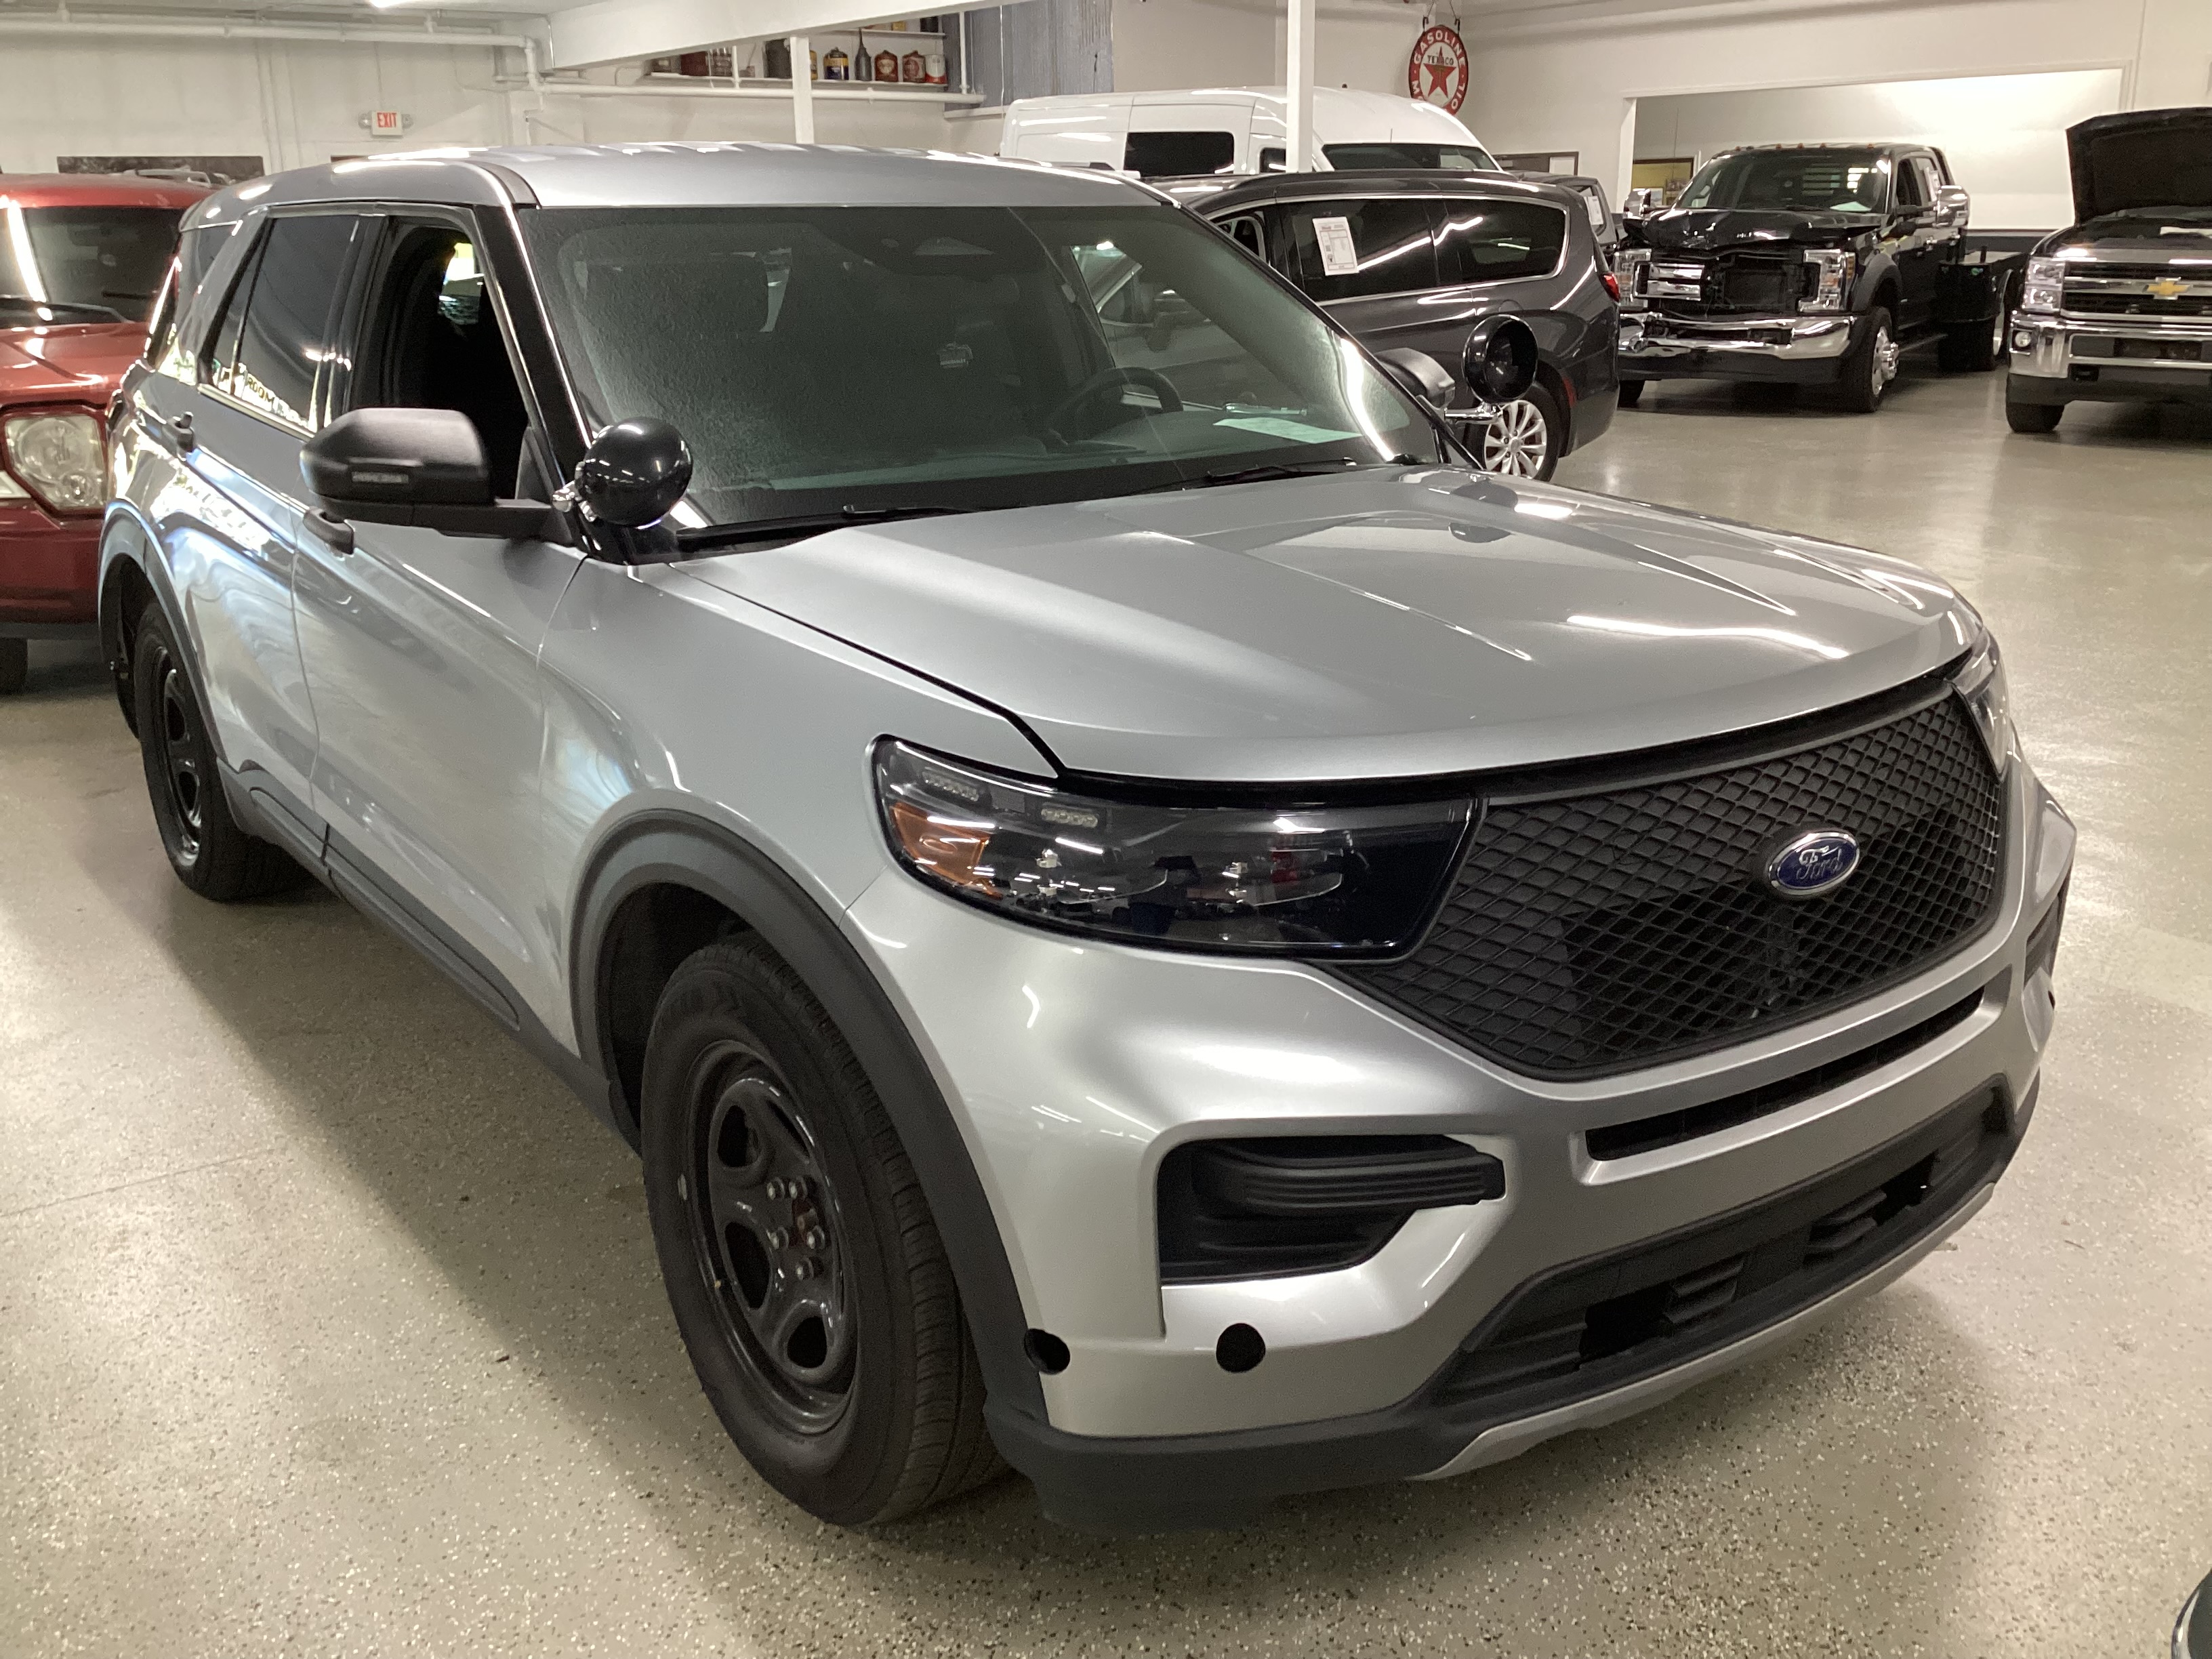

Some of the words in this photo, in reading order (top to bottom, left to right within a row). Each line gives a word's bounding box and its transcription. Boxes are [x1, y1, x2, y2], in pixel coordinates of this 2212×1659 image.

[1414, 30, 1466, 66] GASOLINE
[1427, 55, 1454, 66] TEXACO
[377, 112, 397, 127] EXIT
[1797, 846, 1843, 880] Ford
